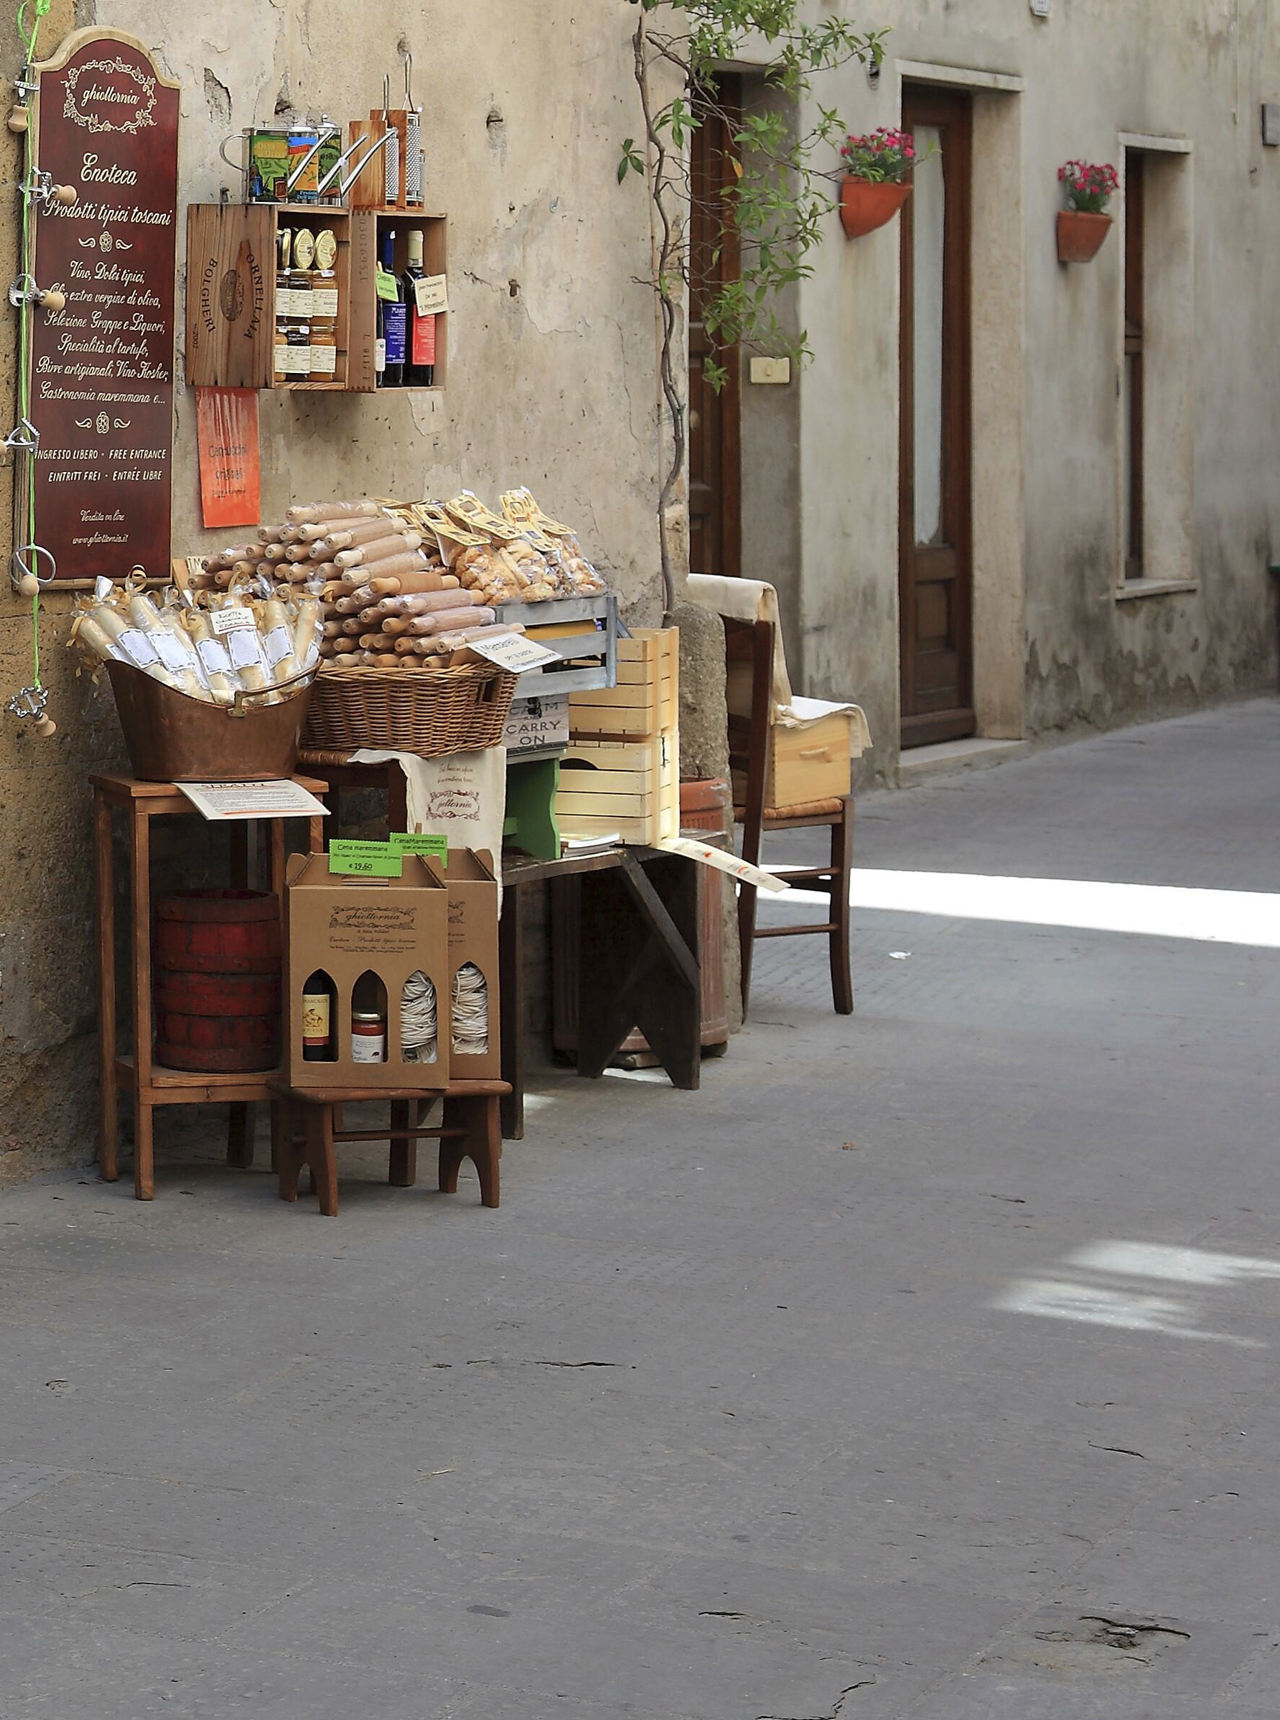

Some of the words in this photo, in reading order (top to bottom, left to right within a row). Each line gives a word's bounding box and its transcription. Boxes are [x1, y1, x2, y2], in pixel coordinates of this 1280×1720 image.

[82, 83, 140, 107] ghiottornia
[80, 152, 137, 186] Enoteca
[42, 195, 98, 219] Prodotti
[98, 203, 131, 228] tipici
[131, 206, 173, 226] toscani
[69, 260, 92, 281] Vino,
[94, 261, 121, 280] Dolci
[120, 268, 145, 287] tipici,
[69, 289, 92, 302] extra
[94, 291, 125, 309] vergine
[127, 289, 138, 305] di
[138, 289, 161, 309] oliva,
[201, 258, 218, 333] BOLGHERI
[243, 253, 264, 339] ORNELLAIA
[43, 308, 87, 328] Selezione
[90, 310, 122, 334] Grappe
[123, 320, 129, 330] e
[129, 312, 166, 336] Liquori,
[57, 332, 104, 356] Specialità
[105, 337, 120, 354] al
[119, 338, 149, 360] tartufo,
[36, 355, 63, 374] Birre
[64, 360, 114, 381] artigianali,
[116, 360, 136, 378] Vino
[136, 360, 169, 382] Kosher,
[39, 380, 96, 400] Gastronomia
[96, 392, 151, 403] maremmana
[34, 449, 71, 460] INGRESSO
[72, 449, 98, 460] LIBERO
[108, 449, 128, 460] FREE
[129, 449, 167, 460] ENTRANCE
[48, 471, 83, 482] EINTRITT
[83, 471, 101, 481] FREI
[112, 466, 140, 481] ENTRÉE
[142, 470, 162, 480] LIBRE
[80, 509, 104, 522] Vendita
[112, 509, 125, 521] line
[508, 702, 559, 715] CAM
[506, 721, 562, 734] CARRY
[520, 735, 546, 745] ON
[345, 910, 400, 923] ghiottornia
